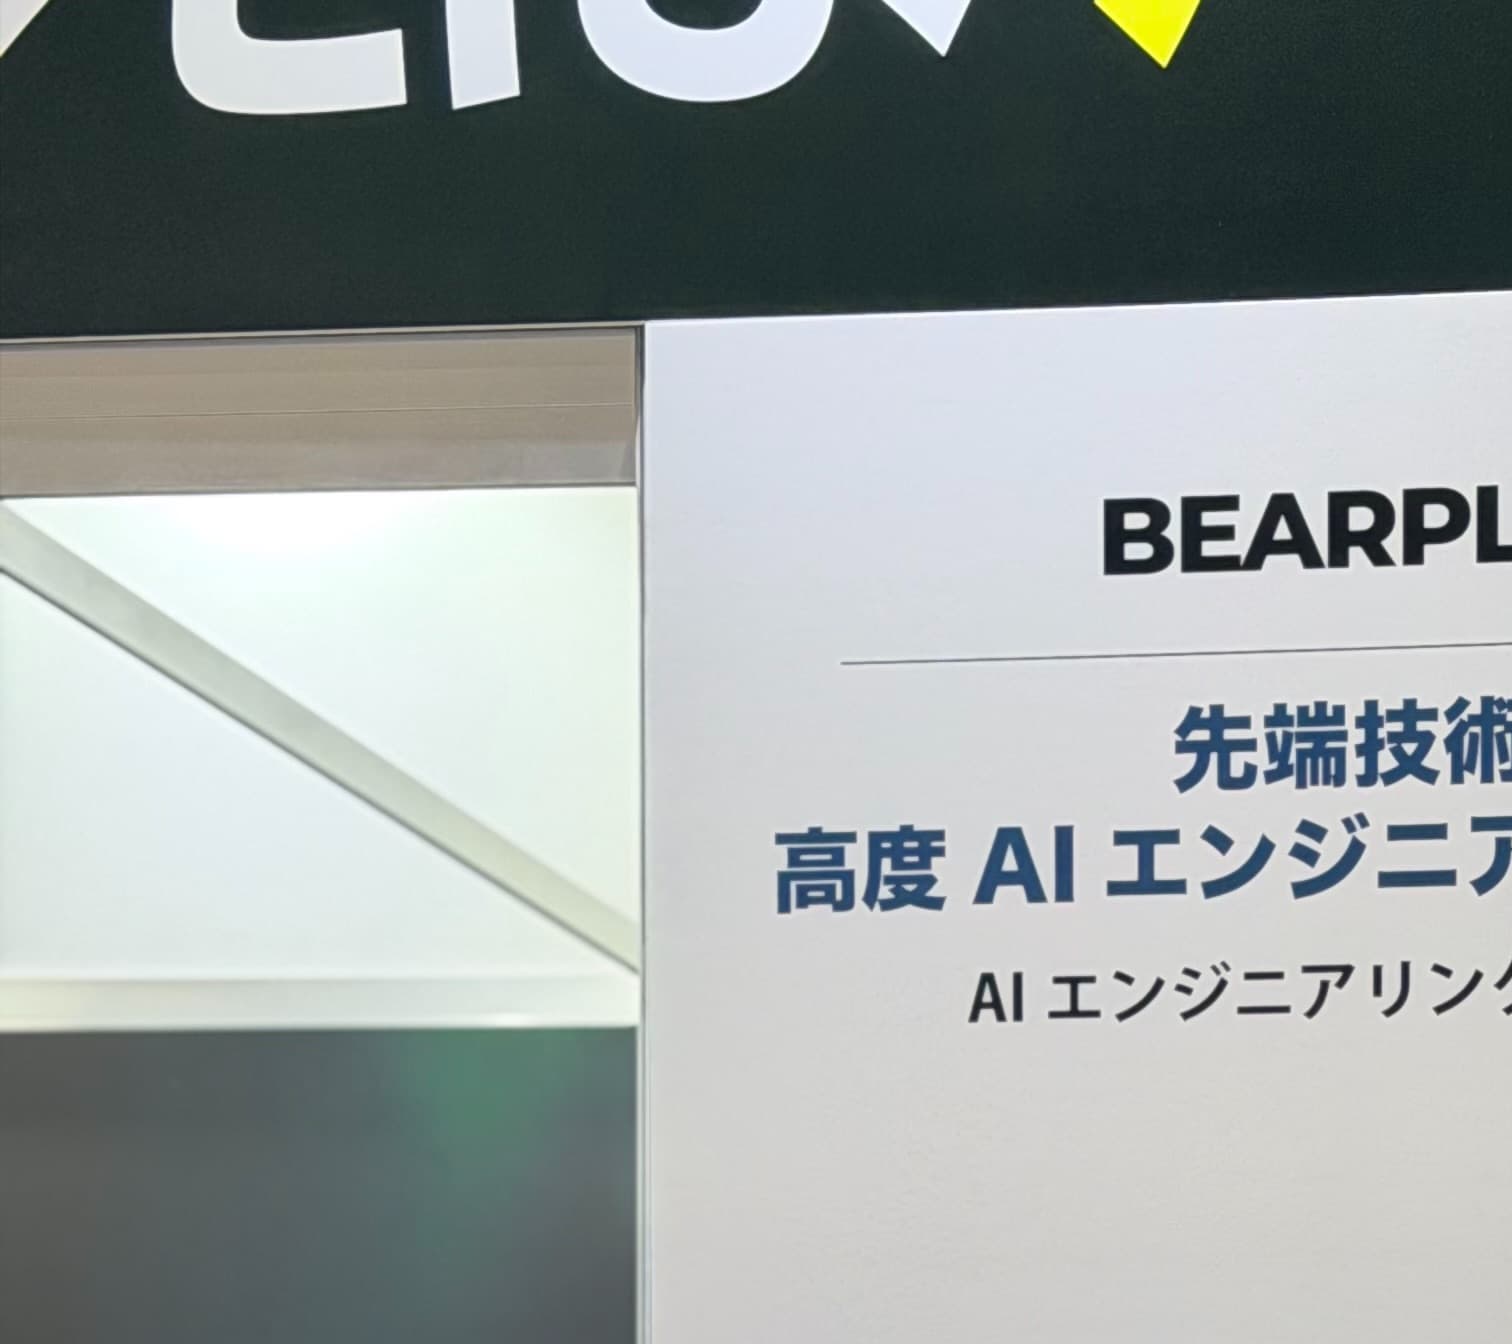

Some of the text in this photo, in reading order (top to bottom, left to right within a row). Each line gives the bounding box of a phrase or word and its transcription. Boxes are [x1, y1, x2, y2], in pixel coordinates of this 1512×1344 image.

[774, 823, 945, 914] 高度
[973, 823, 1073, 906] AI
[969, 967, 1024, 1024] AI
